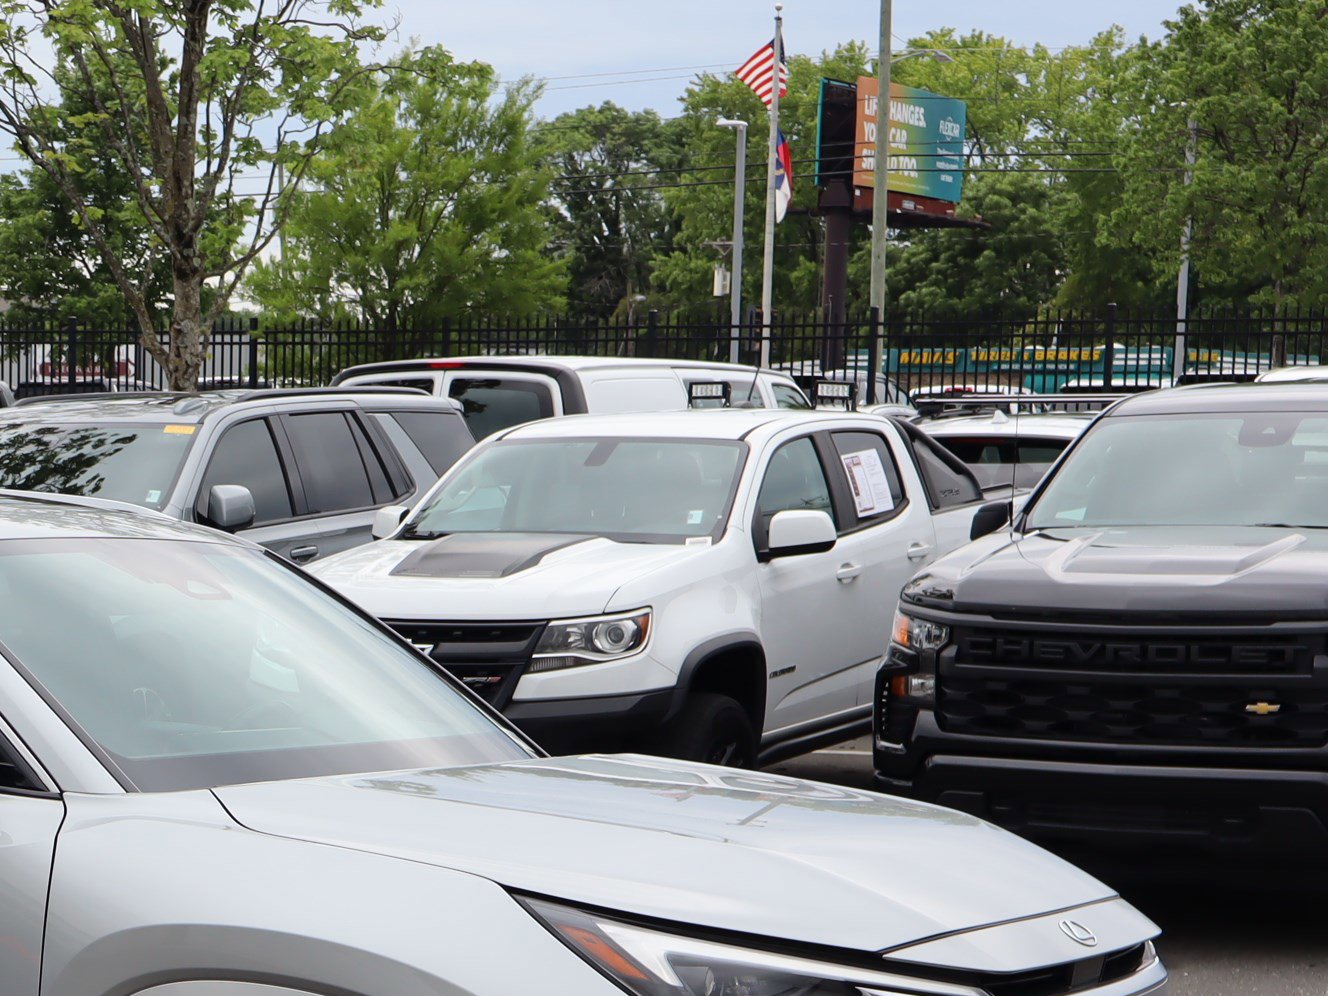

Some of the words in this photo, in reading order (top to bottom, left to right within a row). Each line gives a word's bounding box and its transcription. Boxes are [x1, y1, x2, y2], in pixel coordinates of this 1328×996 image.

[864, 95, 878, 116] LIF
[890, 101, 926, 128] HANGES.
[889, 127, 907, 150] CAR
[964, 637, 1308, 664] CHEVROLET
